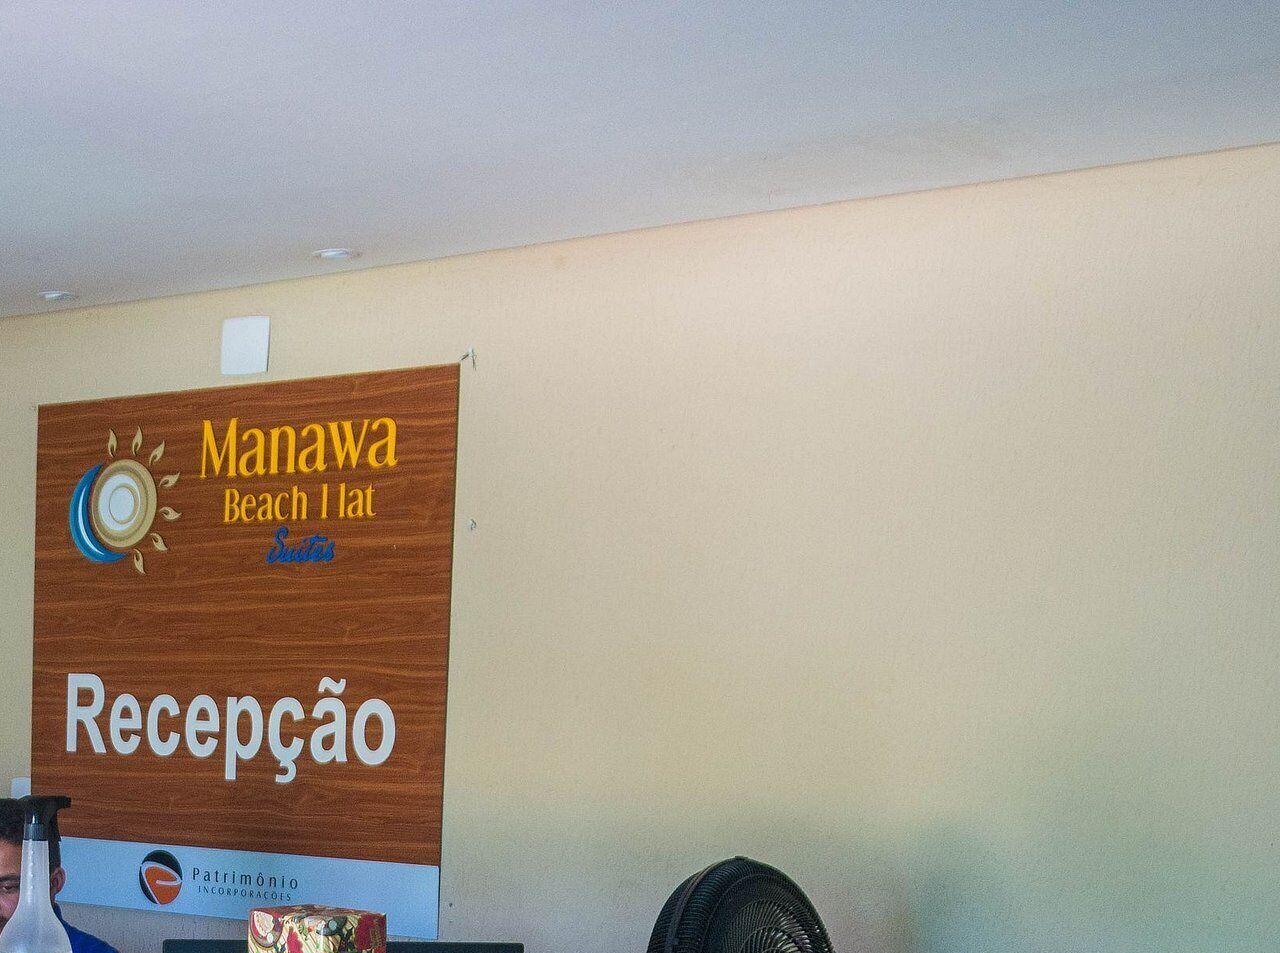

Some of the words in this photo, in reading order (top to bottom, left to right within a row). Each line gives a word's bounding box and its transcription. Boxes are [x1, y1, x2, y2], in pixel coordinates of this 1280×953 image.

[199, 416, 399, 479] Manawa
[223, 485, 308, 523] Beach
[265, 526, 335, 564] Suites
[66, 673, 397, 783] Recepção
[192, 867, 298, 889] Patrimônio
